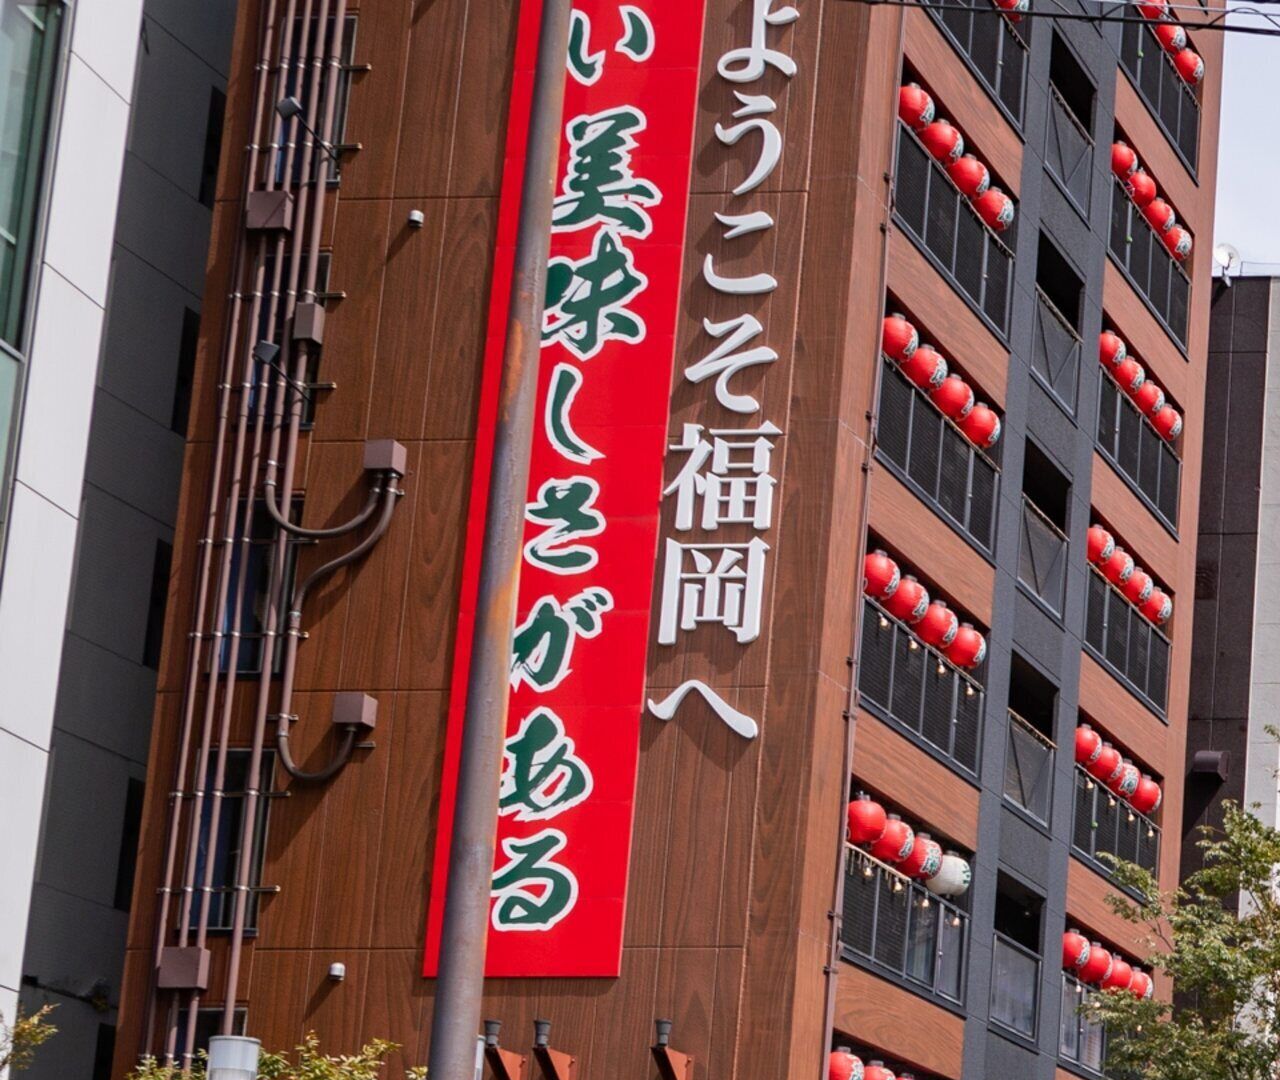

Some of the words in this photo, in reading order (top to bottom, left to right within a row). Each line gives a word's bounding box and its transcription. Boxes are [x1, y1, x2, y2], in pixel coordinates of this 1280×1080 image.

[648, 0, 800, 739] ようこそ福岡へ
